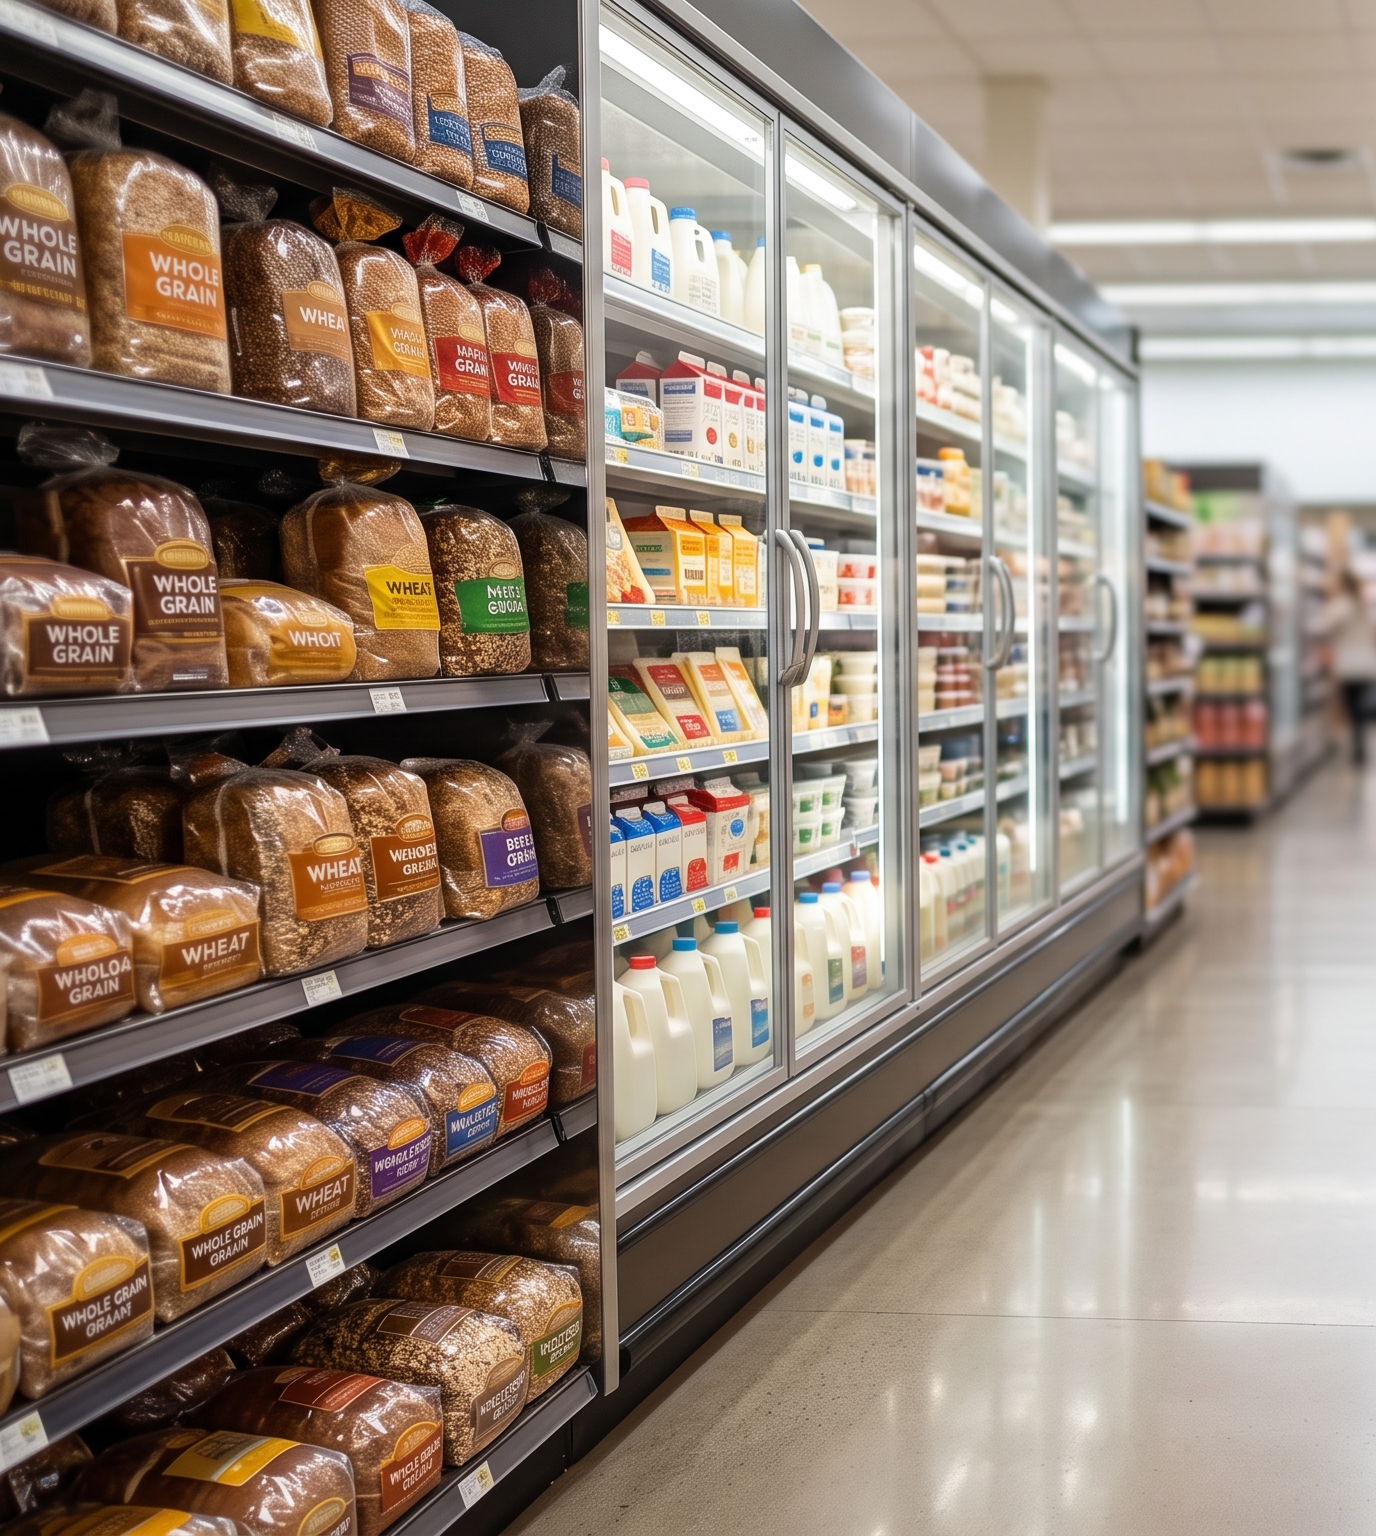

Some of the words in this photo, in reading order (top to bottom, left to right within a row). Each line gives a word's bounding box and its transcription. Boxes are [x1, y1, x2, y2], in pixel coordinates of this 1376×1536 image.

[0, 215, 77, 255] WHOLE
[3, 240, 77, 278] GRAIN
[149, 251, 219, 287] WHOLE
[156, 276, 217, 308] GRAIN
[153, 574, 217, 594] WHOLE
[386, 581, 432, 596] WHEAT
[160, 596, 215, 615] GRAIN
[46, 625, 120, 644] WHOLE
[53, 645, 114, 664] GRAIN
[181, 931, 250, 966] WHEAT
[69, 977, 120, 1005] GRAIN
[295, 1174, 351, 1214] WHEAT
[191, 1228, 232, 1260] WHOLE
[233, 1212, 263, 1239] GRAIN
[61, 1296, 111, 1331] WHOLE
[114, 1274, 148, 1306] GRAIN
